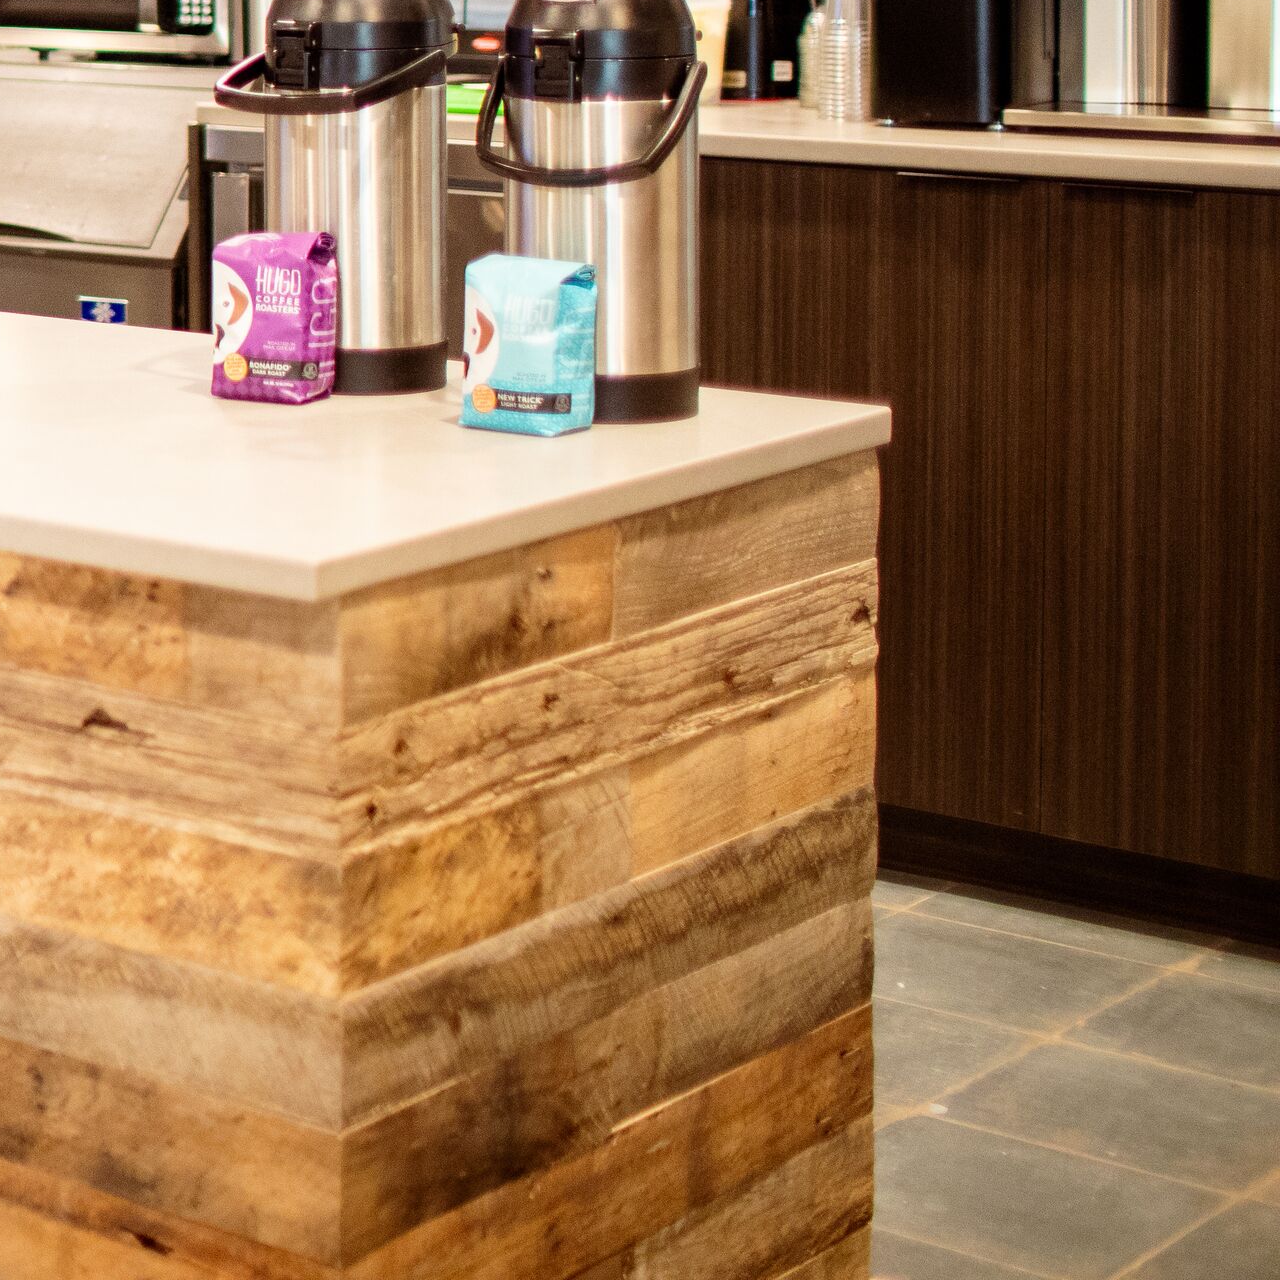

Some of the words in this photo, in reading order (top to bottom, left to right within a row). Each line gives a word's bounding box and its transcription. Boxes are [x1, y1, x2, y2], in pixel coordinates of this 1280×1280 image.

[255, 264, 301, 296] HUGO
[256, 295, 300, 306] COFFEE
[497, 393, 516, 402] NEW
